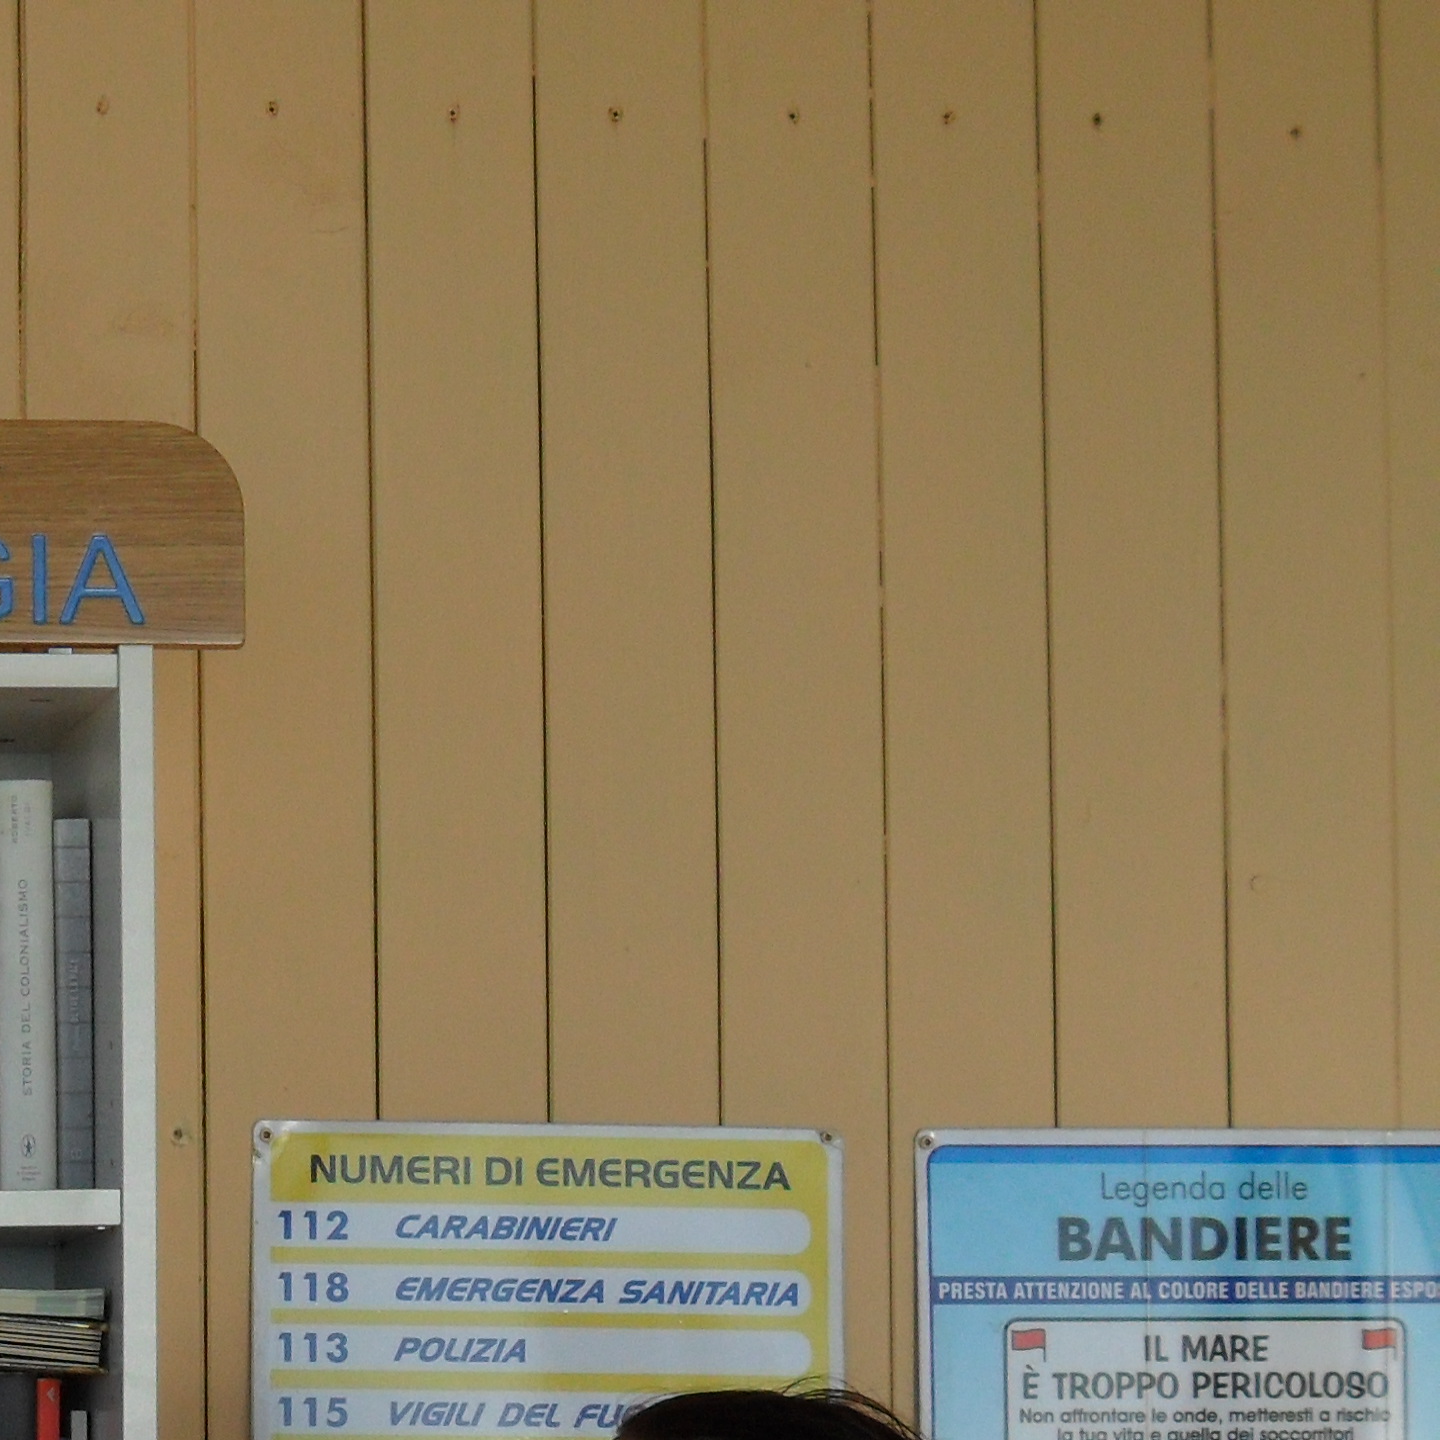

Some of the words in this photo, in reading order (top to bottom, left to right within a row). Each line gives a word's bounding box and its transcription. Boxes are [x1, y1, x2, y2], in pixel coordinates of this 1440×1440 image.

[17, 879, 31, 997] COLONIALISMO
[20, 1002, 31, 1031] DEL
[22, 1042, 32, 1097] STORIA
[309, 1154, 472, 1187] NUMERI
[484, 1156, 524, 1187] DI
[536, 1158, 791, 1192] EMERGENZA
[1100, 1172, 1226, 1208] Legenda
[1238, 1171, 1308, 1200] delle
[277, 1210, 349, 1241] 112
[395, 1214, 619, 1243] CARABINIERI
[1057, 1216, 1353, 1261] BANDIERE
[277, 1271, 349, 1302] 118
[395, 1276, 605, 1304] EMERGENZA
[619, 1279, 800, 1307] SANITARIA
[938, 1282, 1008, 1300] PRESTA
[1014, 1282, 1124, 1299] ATTENZIONE
[1130, 1282, 1152, 1299] AL
[1158, 1281, 1229, 1299] COLORE
[1235, 1281, 1289, 1299] DELLE
[1295, 1281, 1384, 1299] BANDIERE
[1390, 1281, 1440, 1299] ESPO
[277, 1332, 349, 1363] 113
[393, 1337, 528, 1364] POLIZIA
[1144, 1335, 1168, 1363] IL
[1181, 1334, 1270, 1363] MARE
[1022, 1365, 1040, 1400] È
[1051, 1372, 1179, 1400] TROPPO
[1192, 1372, 1389, 1400] PERICOLOSO
[277, 1396, 349, 1428] 115
[390, 1402, 486, 1427] VIGILI
[497, 1403, 561, 1428] DEL
[1020, 1408, 1055, 1424] Non
[1059, 1407, 1146, 1424] affrontare
[1151, 1407, 1168, 1423] le
[1173, 1407, 1223, 1426] onde,
[1229, 1407, 1314, 1423] metteresti
[1319, 1411, 1330, 1423] a
[1336, 1407, 1391, 1423] rischio
